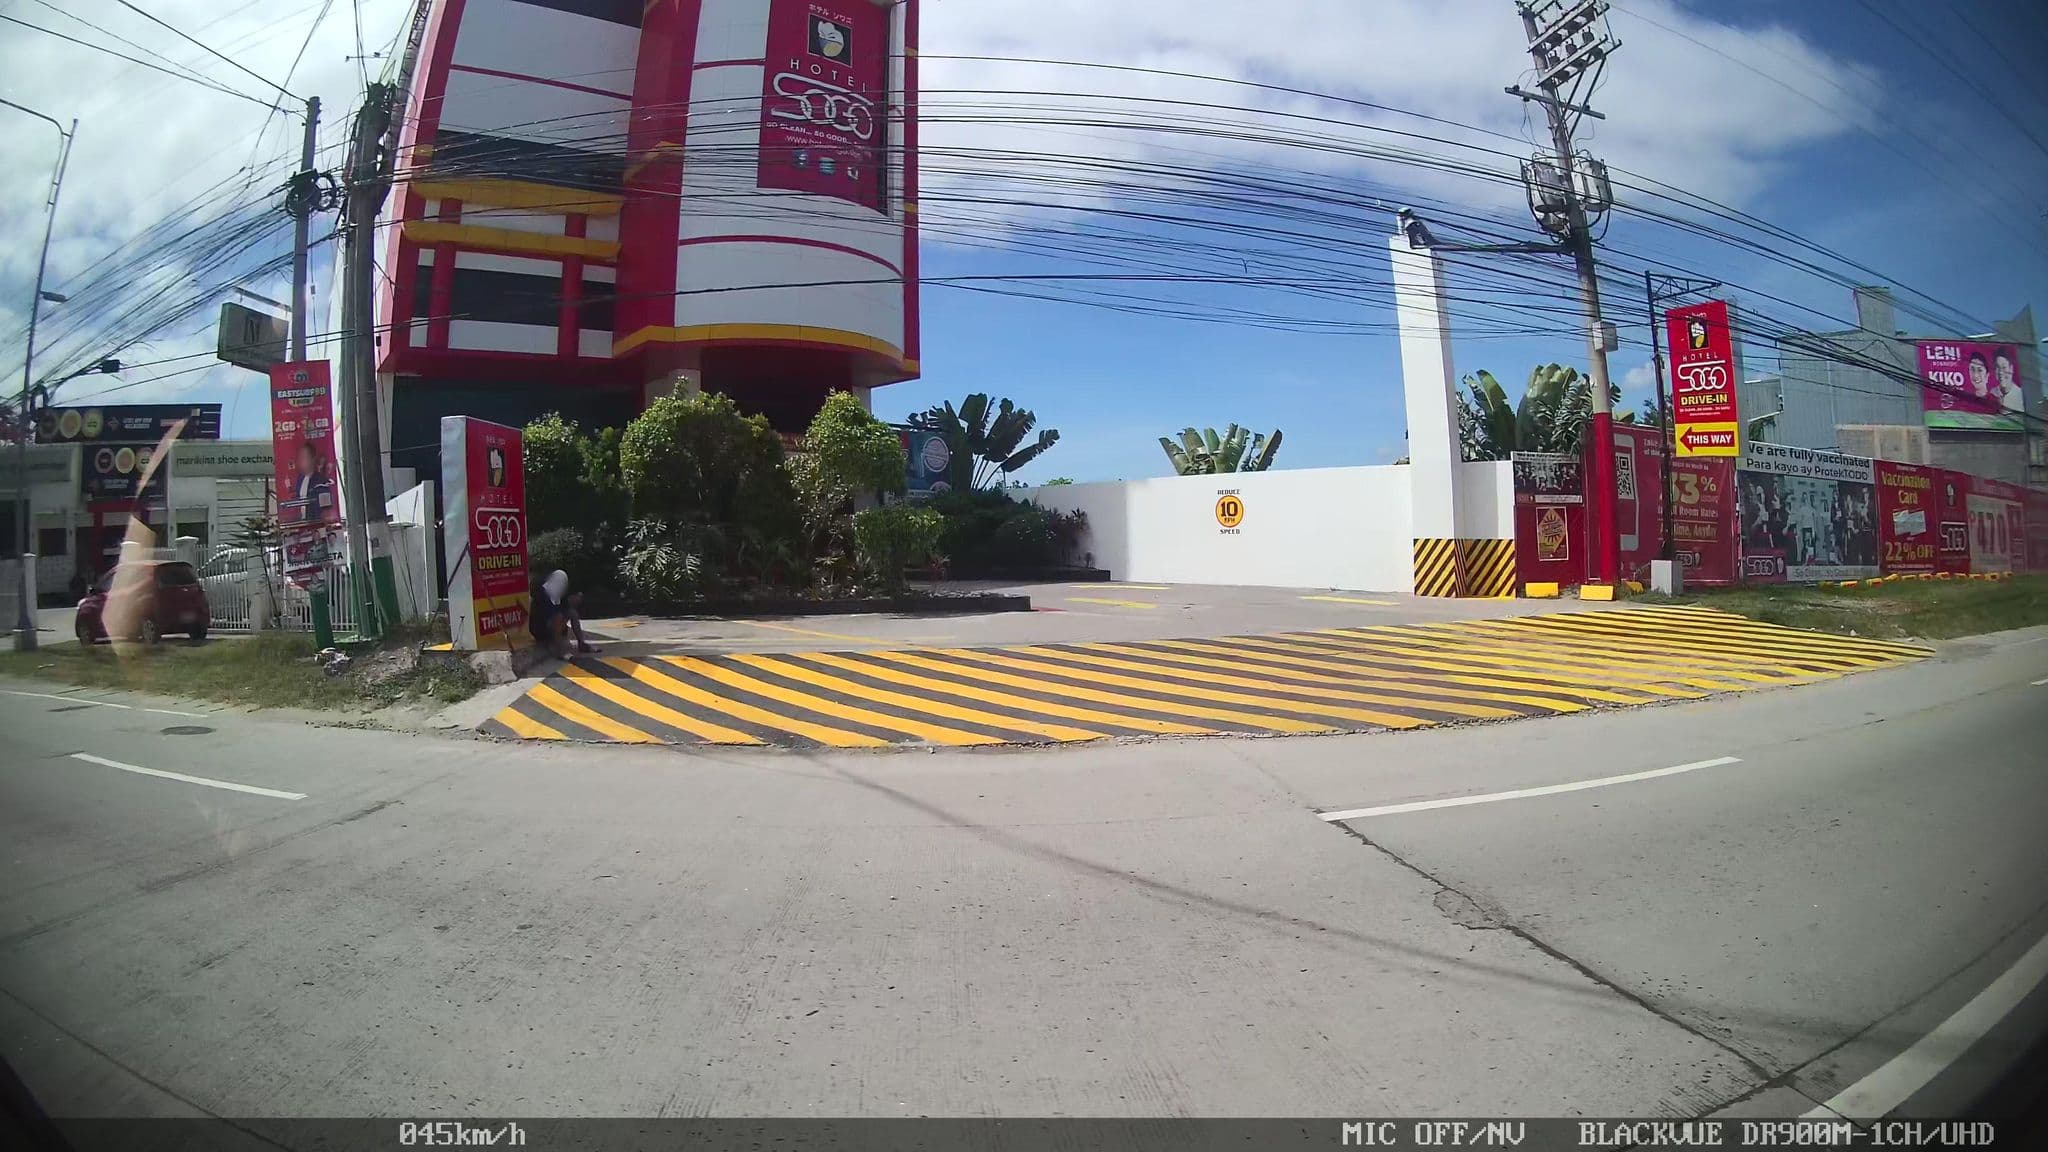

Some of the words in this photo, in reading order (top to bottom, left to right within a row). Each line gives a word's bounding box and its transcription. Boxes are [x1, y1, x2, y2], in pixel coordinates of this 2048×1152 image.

[771, 72, 875, 139] SOGO
[1682, 352, 1718, 362] HOTEL
[1678, 360, 1727, 393] SOGO
[1928, 371, 1965, 387] KIKO
[1680, 394, 1728, 406] DRIVE-IN
[1687, 434, 1709, 445] THIS
[1711, 433, 1732, 444] WAY
[217, 454, 239, 465] shoe
[1767, 446, 1787, 457] are
[1789, 447, 1815, 464] fully
[1816, 452, 1870, 469] vaccinated
[1746, 458, 1772, 471] Para
[1774, 460, 1799, 474] kayo
[1801, 465, 1813, 477] ay
[1881, 471, 1931, 489] Vaccination
[1898, 490, 1918, 505] Card
[1220, 500, 1239, 517] 10
[475, 507, 521, 550] SOGO
[478, 553, 522, 570] DRIVE-IN
[480, 614, 502, 631] THIS
[503, 609, 522, 625] WAY
